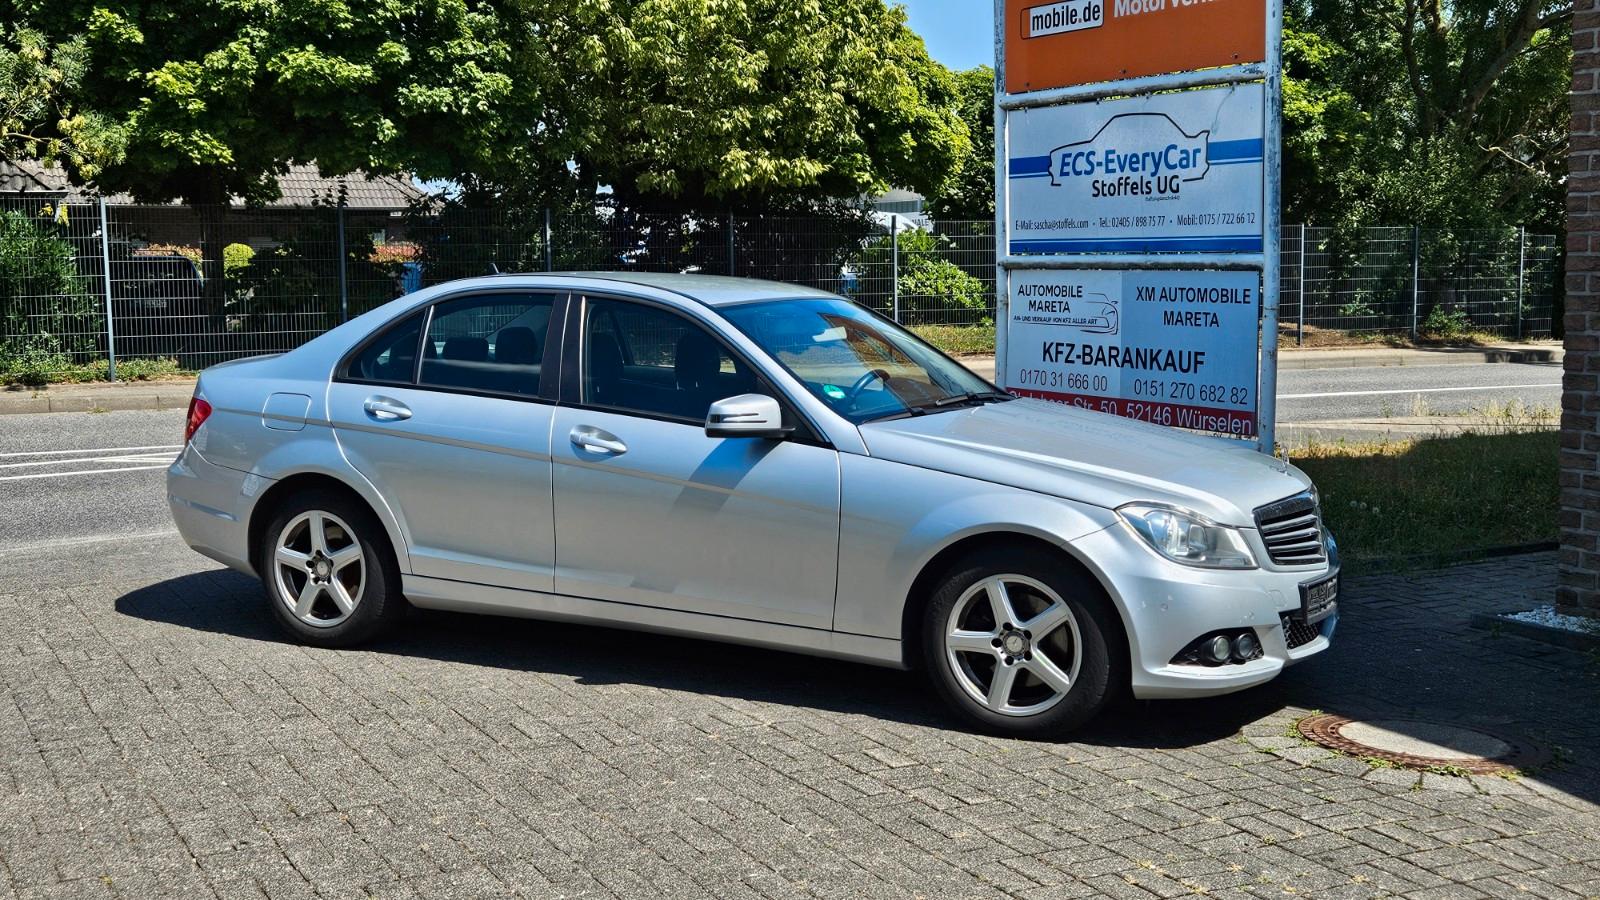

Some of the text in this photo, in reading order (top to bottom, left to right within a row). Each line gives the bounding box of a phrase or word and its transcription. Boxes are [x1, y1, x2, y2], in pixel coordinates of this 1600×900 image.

[1032, 3, 1100, 31] mobile.de
[1059, 144, 1201, 177] ECS-EveryCar
[1092, 175, 1180, 197] Stoffels UG
[1034, 218, 1089, 231] sascha@stoffels.com
[1111, 217, 1130, 227] 02405
[1135, 216, 1147, 227] 898
[1148, 216, 1156, 227] 75
[1157, 216, 1165, 226] 77
[1177, 214, 1198, 226] Mobil:
[1199, 214, 1216, 225] 0175
[1222, 213, 1235, 224] 722
[1236, 213, 1245, 224] 66
[1247, 212, 1256, 224] 12
[1017, 284, 1083, 298] AUTOMOBILE
[1136, 286, 1251, 305] XM AUTOMOBILE
[1028, 300, 1071, 313] MARETA
[1163, 310, 1220, 328] MARETA
[1042, 341, 1206, 374] KFZ-BARANKAUF
[1020, 368, 1108, 392] 0170 31 666 00
[1134, 378, 1248, 405] 0151 270 682 82
[1126, 403, 1172, 426] 52146
[1176, 407, 1252, 435] Würselen
